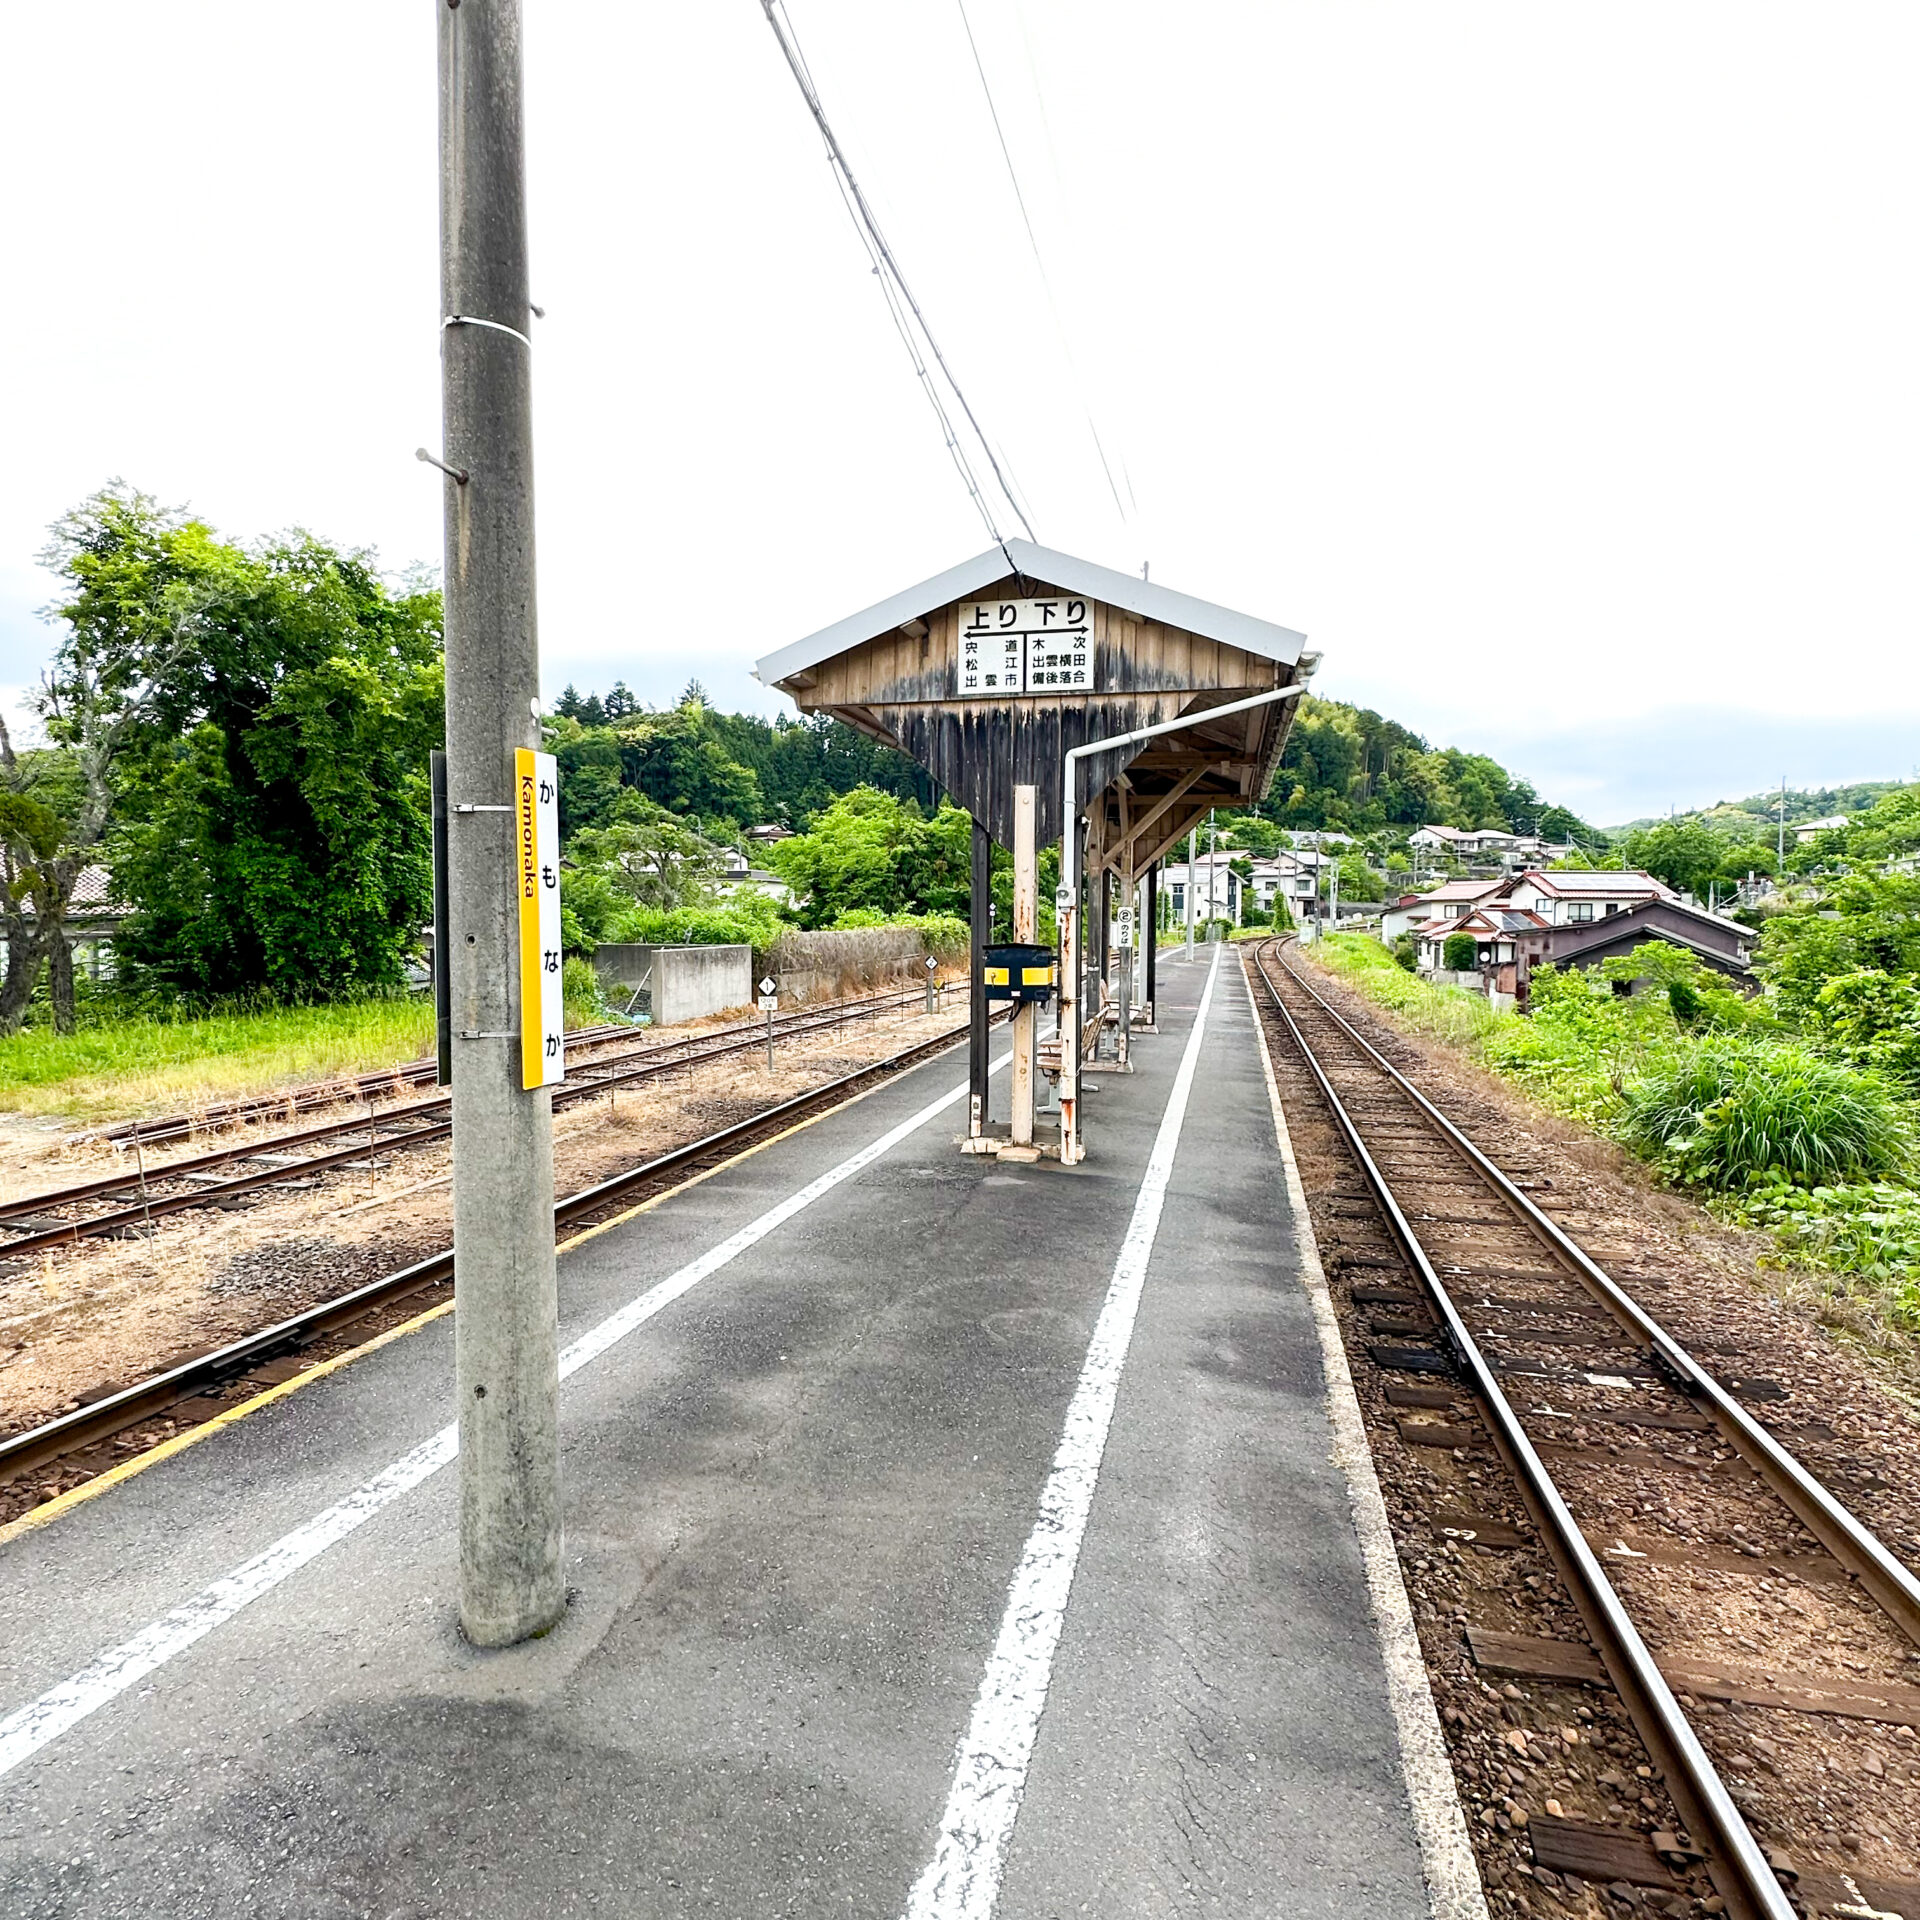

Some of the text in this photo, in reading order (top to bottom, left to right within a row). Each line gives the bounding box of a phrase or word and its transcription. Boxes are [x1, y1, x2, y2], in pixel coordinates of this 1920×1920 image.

[967, 605, 1017, 630] 上り
[1034, 601, 1086, 626] 下り
[1033, 636, 1086, 650] 木次
[966, 657, 1018, 671] 松江
[1033, 654, 1086, 668] 出雲横田
[966, 674, 1018, 688] 出雲市
[1033, 671, 1086, 684] 備後落合
[522, 776, 535, 898] Kamonaka
[540, 780, 560, 1057] かもなか
